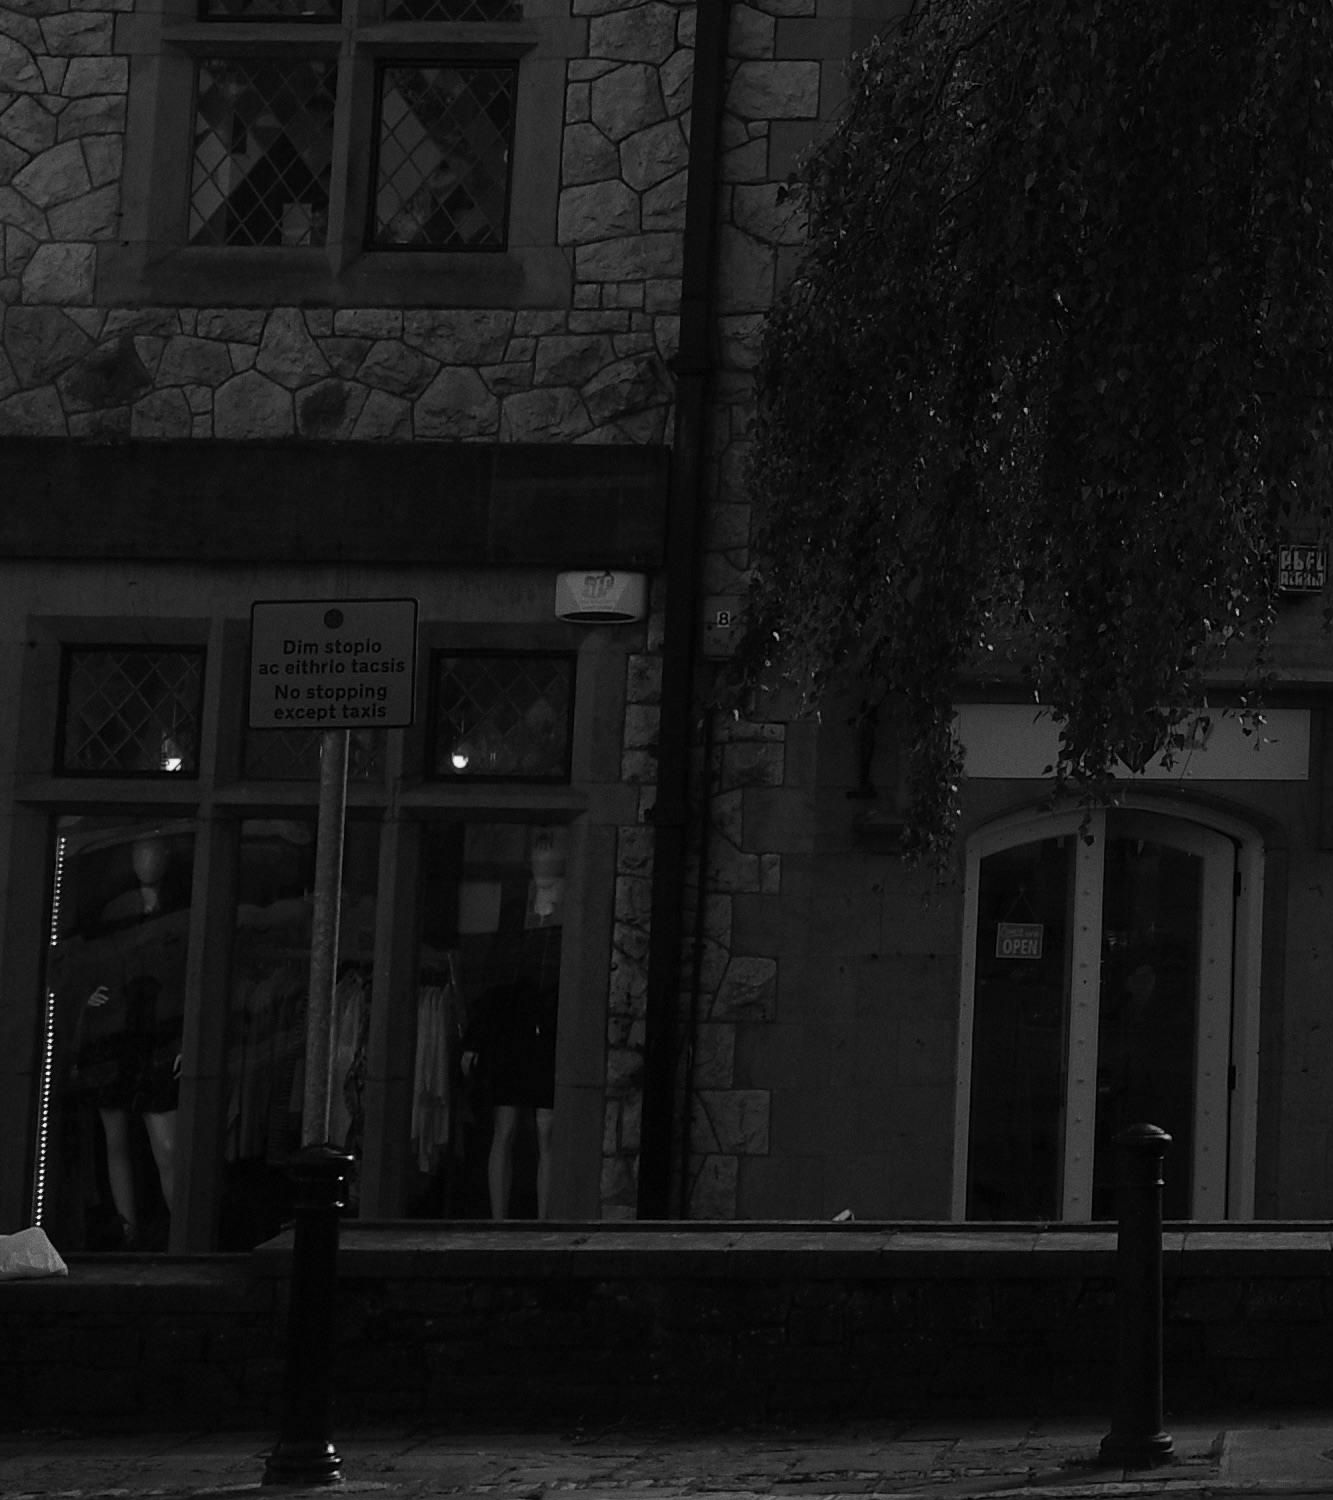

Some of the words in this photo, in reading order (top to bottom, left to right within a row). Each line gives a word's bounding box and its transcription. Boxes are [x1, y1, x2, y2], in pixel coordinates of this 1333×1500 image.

[283, 640, 319, 655] Dim
[325, 638, 382, 656] stopio
[259, 663, 280, 675] ac
[285, 660, 345, 675] eithrio
[352, 658, 406, 674] tacsis
[275, 685, 301, 700] No
[307, 684, 388, 702] stopping
[274, 704, 337, 721] except
[343, 703, 387, 719] taxis
[1002, 938, 1039, 956] OPEN
